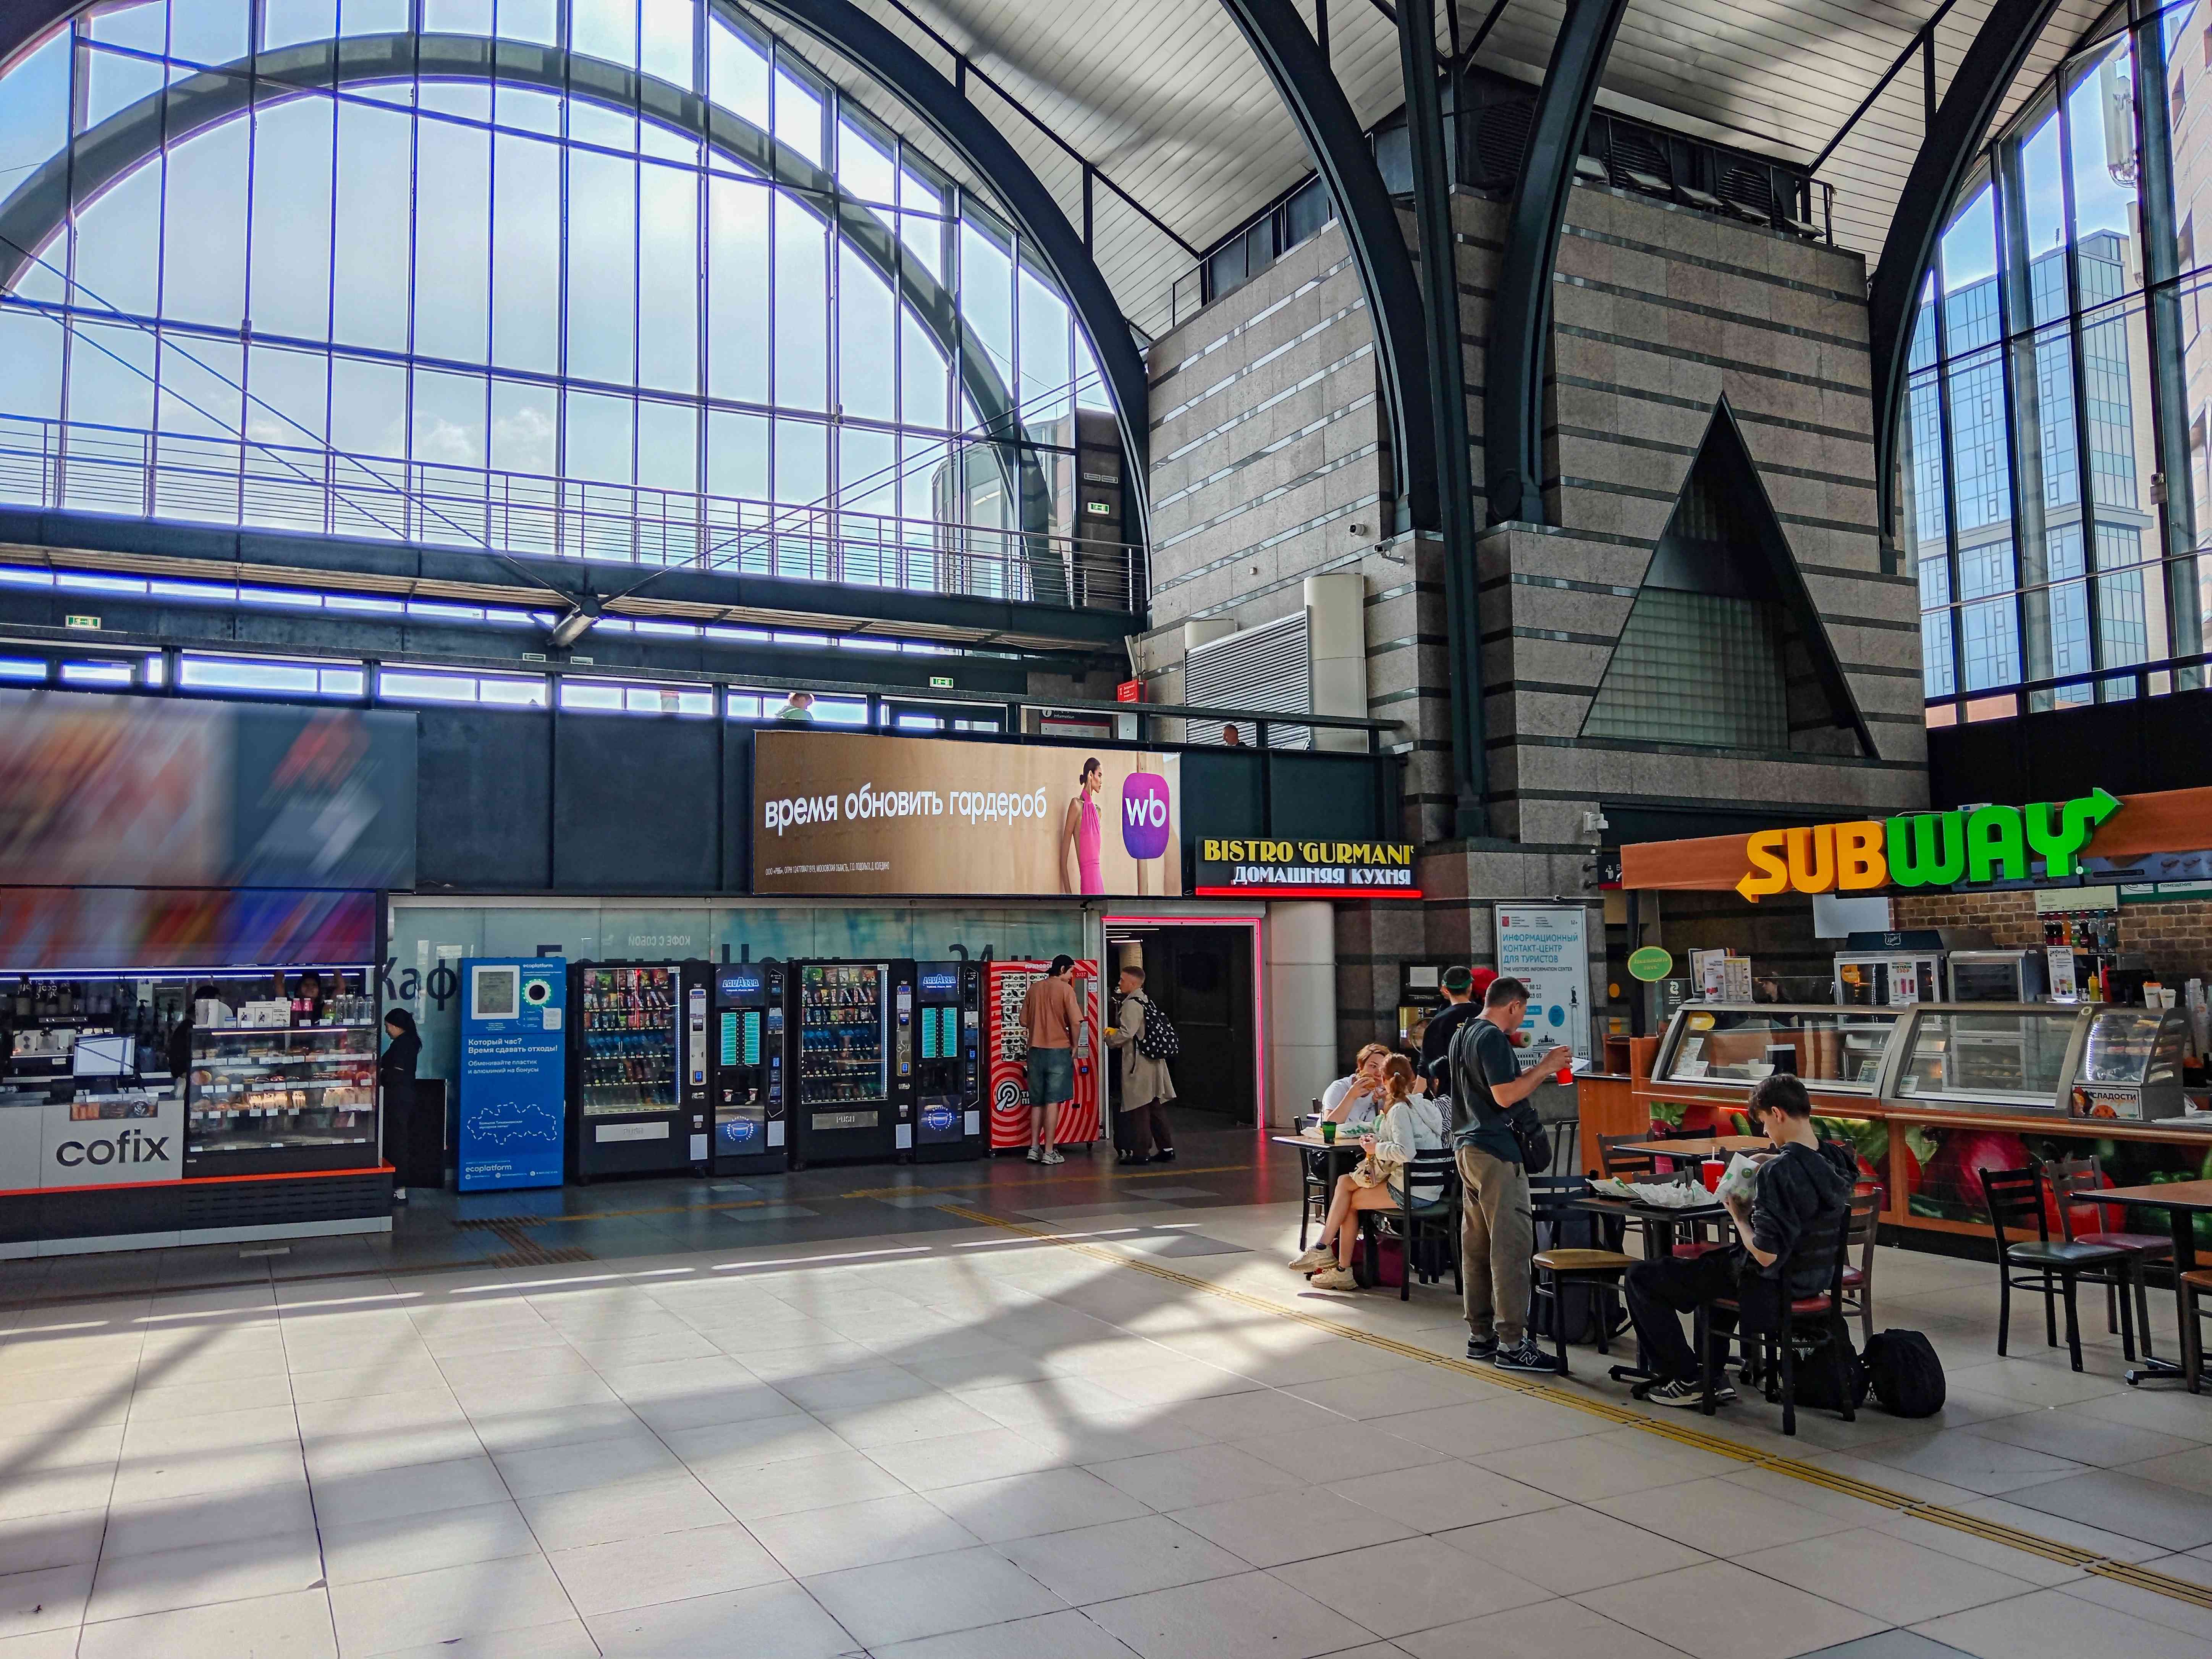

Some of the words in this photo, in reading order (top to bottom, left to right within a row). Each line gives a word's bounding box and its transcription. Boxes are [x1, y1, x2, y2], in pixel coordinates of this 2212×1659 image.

[765, 794, 837, 836] время
[844, 782, 943, 820] обновить
[949, 786, 1047, 825] гардероб
[1125, 789, 1166, 827] wb
[1735, 787, 2124, 904] SUBWAY
[1204, 839, 1293, 863] BISTRO
[817, 863, 835, 872] МОСКОВСКАЯ
[856, 862, 871, 871] ПОДОЛЬСК,
[875, 862, 889, 870] КОЛЕДИНО
[1231, 866, 1345, 884] ДОМАШНЯЯ
[1351, 867, 1411, 885] КУХНЯ
[1503, 932, 1578, 942] ИНФОРМАЦИОННЫЙ
[1503, 944, 1562, 953] КОНТАКТ-ЦЕНТР
[1504, 955, 1519, 964] ДЛЯ
[1522, 955, 1559, 963] ТУРИСТОВ
[722, 977, 759, 987] LAVAZZA
[923, 974, 956, 984] LAVAZZA
[468, 1047, 494, 1055] Время
[57, 1129, 170, 1167] cofix
[466, 1164, 512, 1173] ecoplatform
[1519, 1352, 1538, 1365] N
